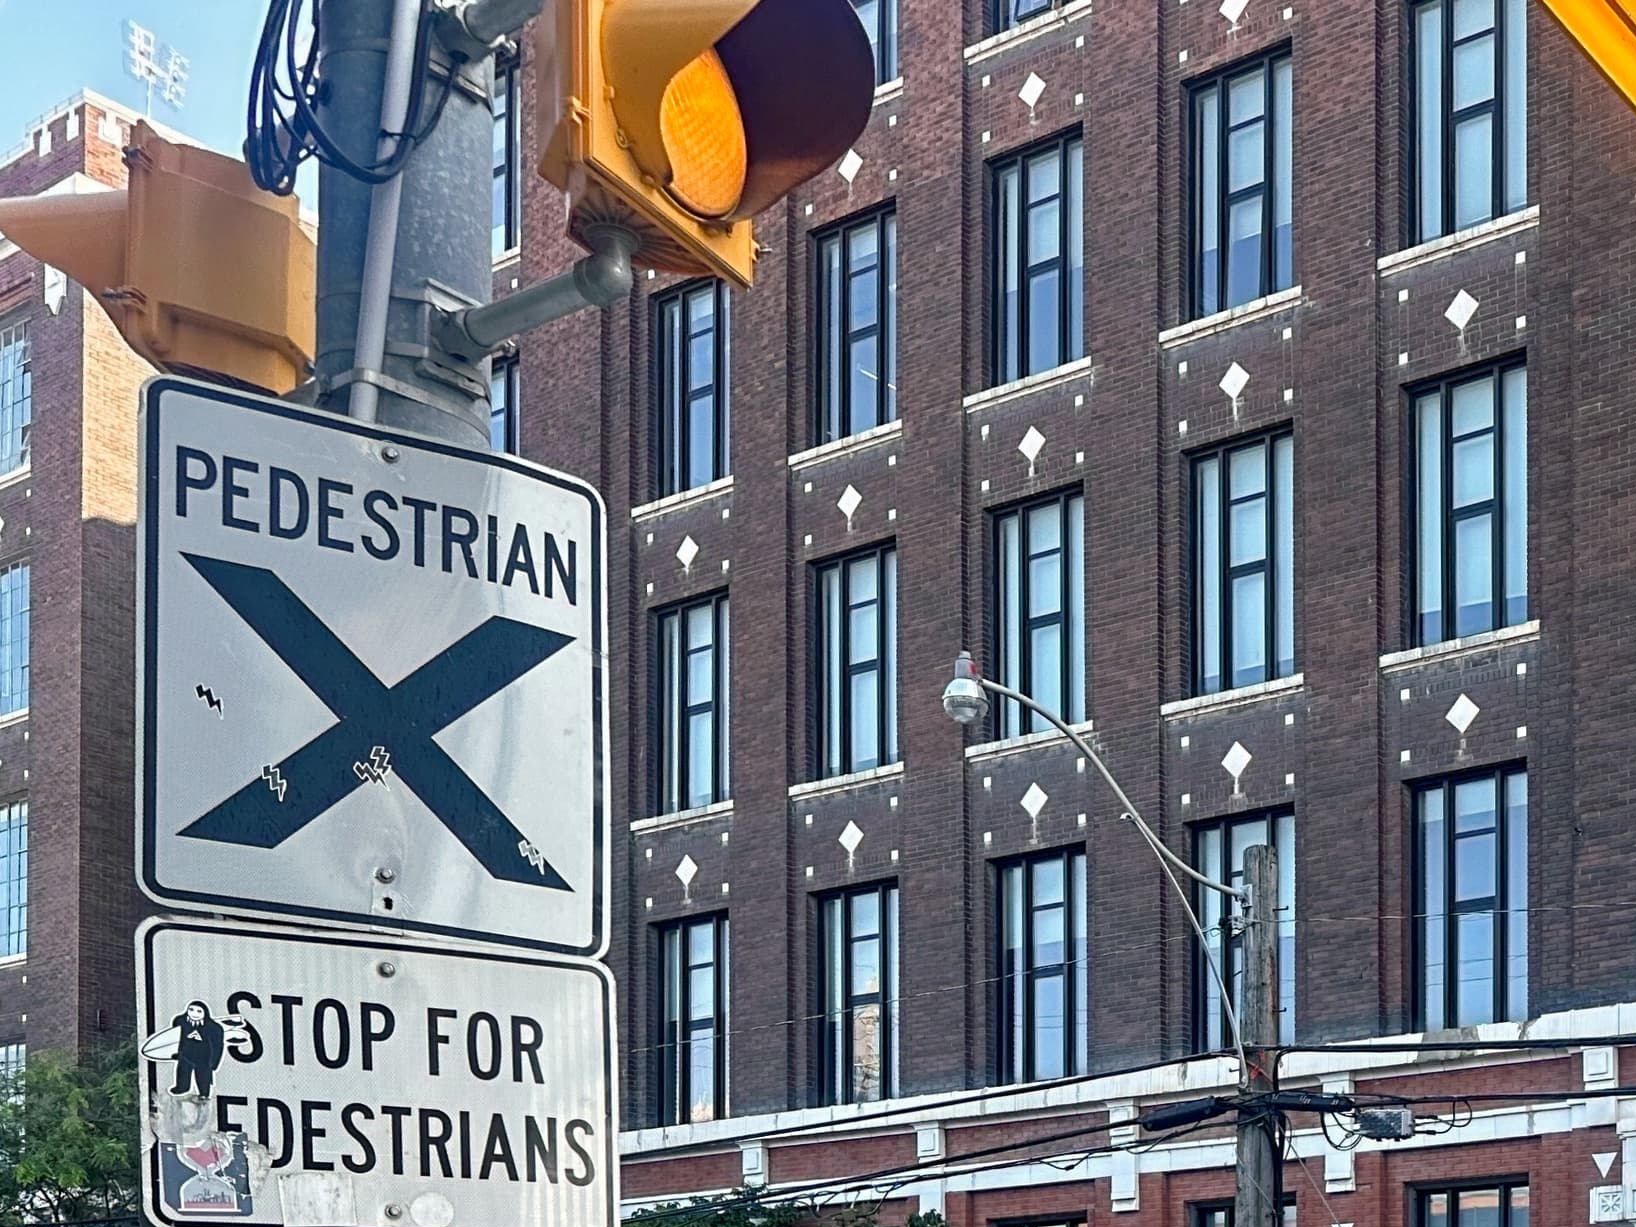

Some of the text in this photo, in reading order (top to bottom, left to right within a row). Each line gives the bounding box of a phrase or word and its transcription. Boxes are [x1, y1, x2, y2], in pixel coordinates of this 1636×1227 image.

[175, 444, 577, 607] PEDESTRIAN
[226, 991, 544, 1085] STOP FOR
[190, 1094, 596, 1187] EDESTRIANS
